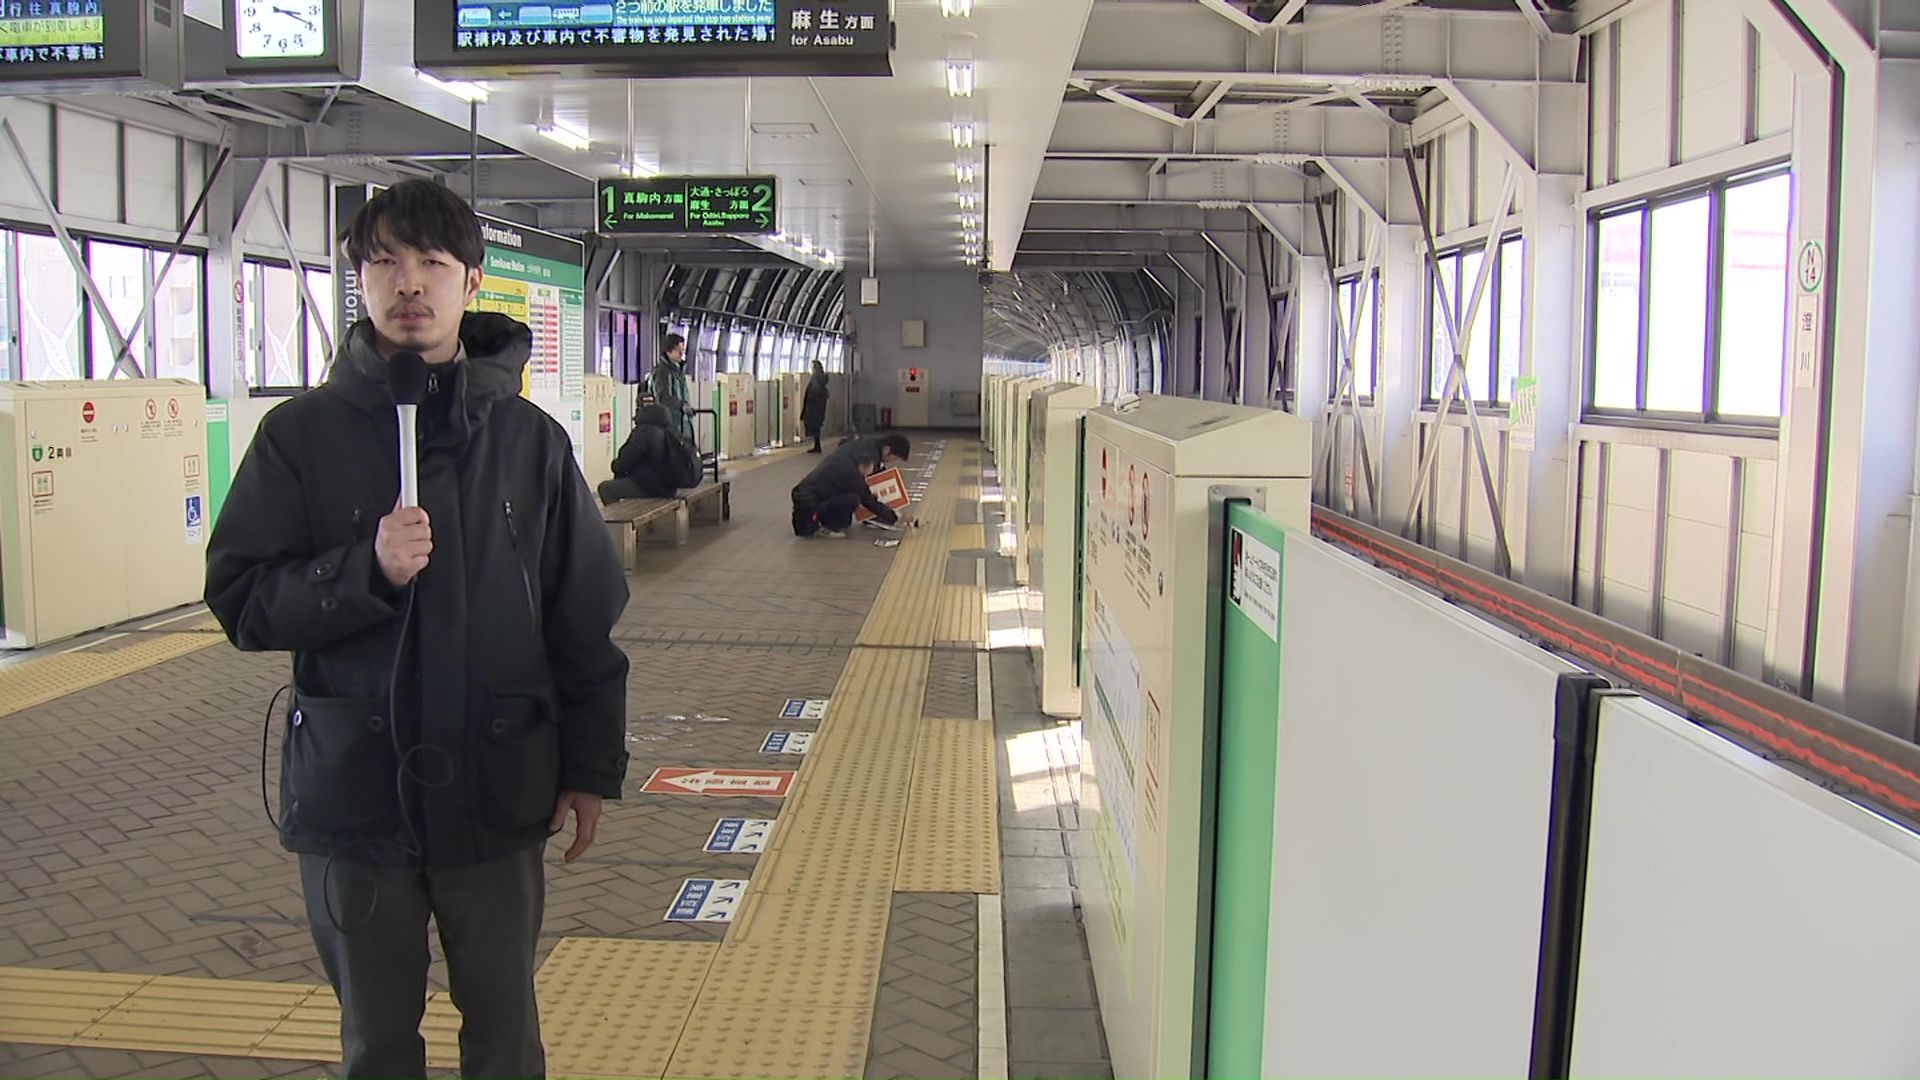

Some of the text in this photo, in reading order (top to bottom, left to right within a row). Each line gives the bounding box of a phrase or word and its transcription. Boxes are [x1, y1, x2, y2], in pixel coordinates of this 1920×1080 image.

[247, 6, 257, 17] 9
[309, 5, 318, 15] 3
[252, 22, 262, 33] 8
[844, 15, 874, 30] 方面
[263, 34, 272, 45] 7
[278, 38, 288, 50] 6
[293, 33, 303, 45] 5
[791, 34, 854, 46] for Asabu
[601, 186, 615, 213] 1
[623, 191, 661, 205] 真駒内
[751, 184, 773, 212] 2
[1807, 248, 1816, 264] N
[1804, 266, 1816, 283] 14
